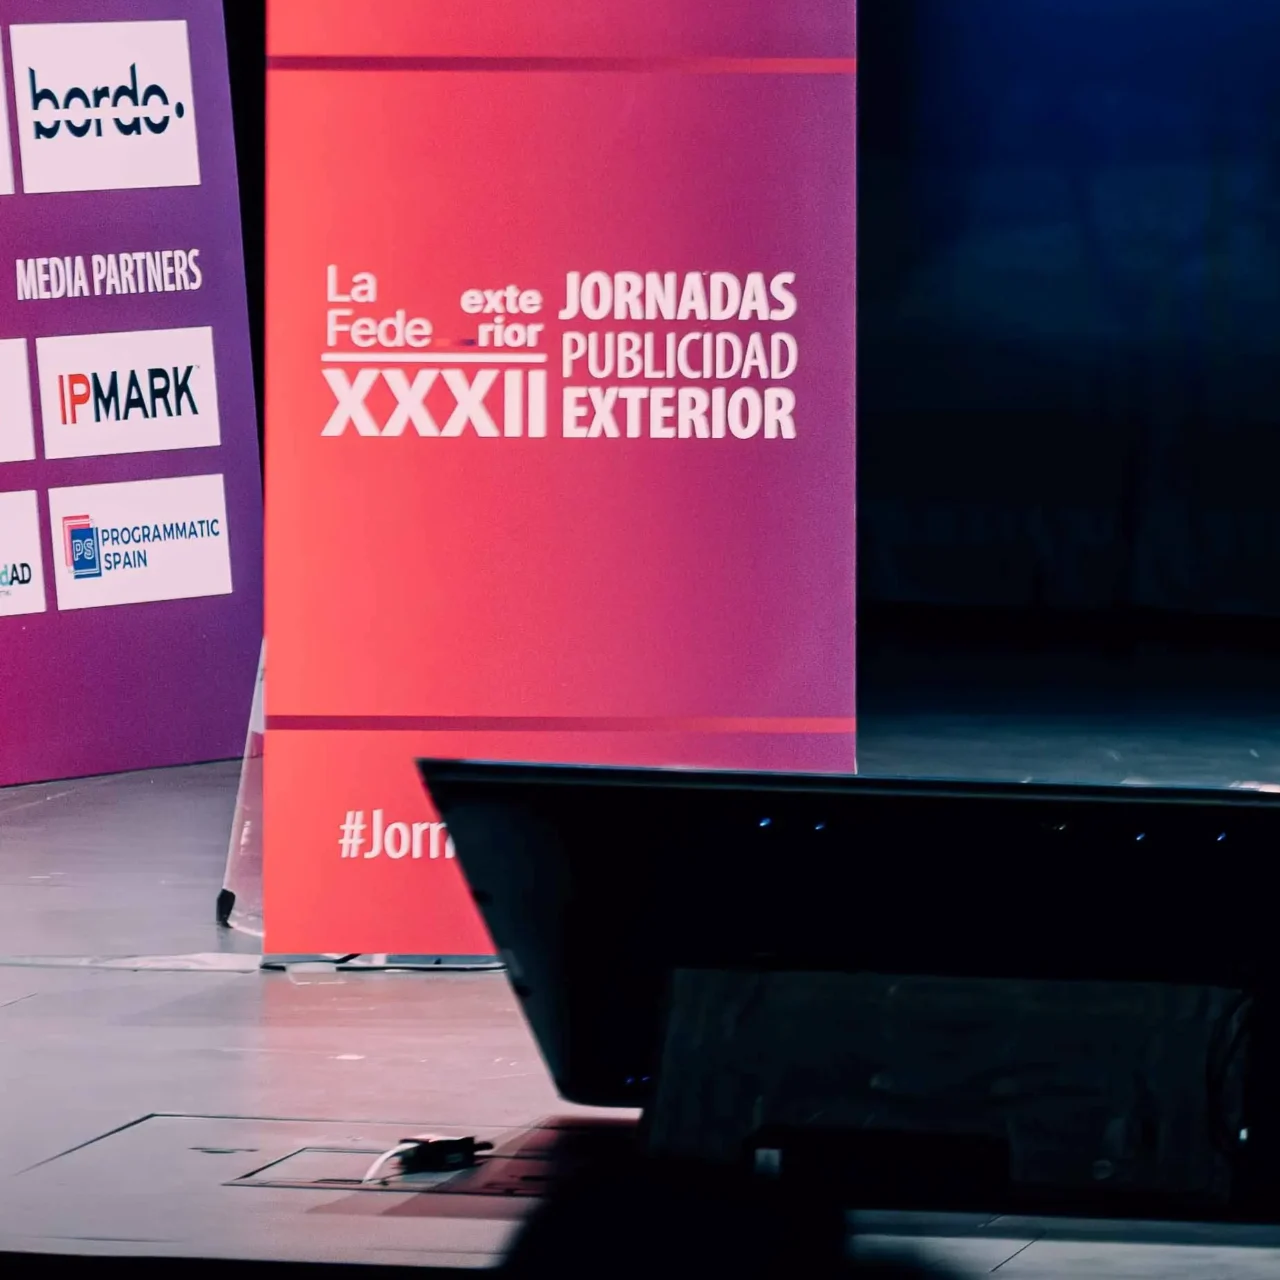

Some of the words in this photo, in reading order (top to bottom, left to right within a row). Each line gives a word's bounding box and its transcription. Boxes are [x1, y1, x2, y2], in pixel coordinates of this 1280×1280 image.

[16, 255, 90, 300] MEDIA
[91, 249, 202, 296] PARTNERS
[326, 264, 378, 304] La
[557, 270, 798, 322] JORNADAS
[460, 283, 544, 315] exte
[326, 309, 433, 349] Fede
[477, 317, 545, 349] rior
[561, 331, 799, 380] PUBLICIDAD
[58, 365, 199, 425] IPMARK
[320, 368, 547, 439] XXXII
[562, 386, 798, 440] EXTERIOR
[73, 538, 96, 561] PS
[101, 519, 220, 547] PROGRAMMATIC
[104, 549, 148, 570] SPAIN
